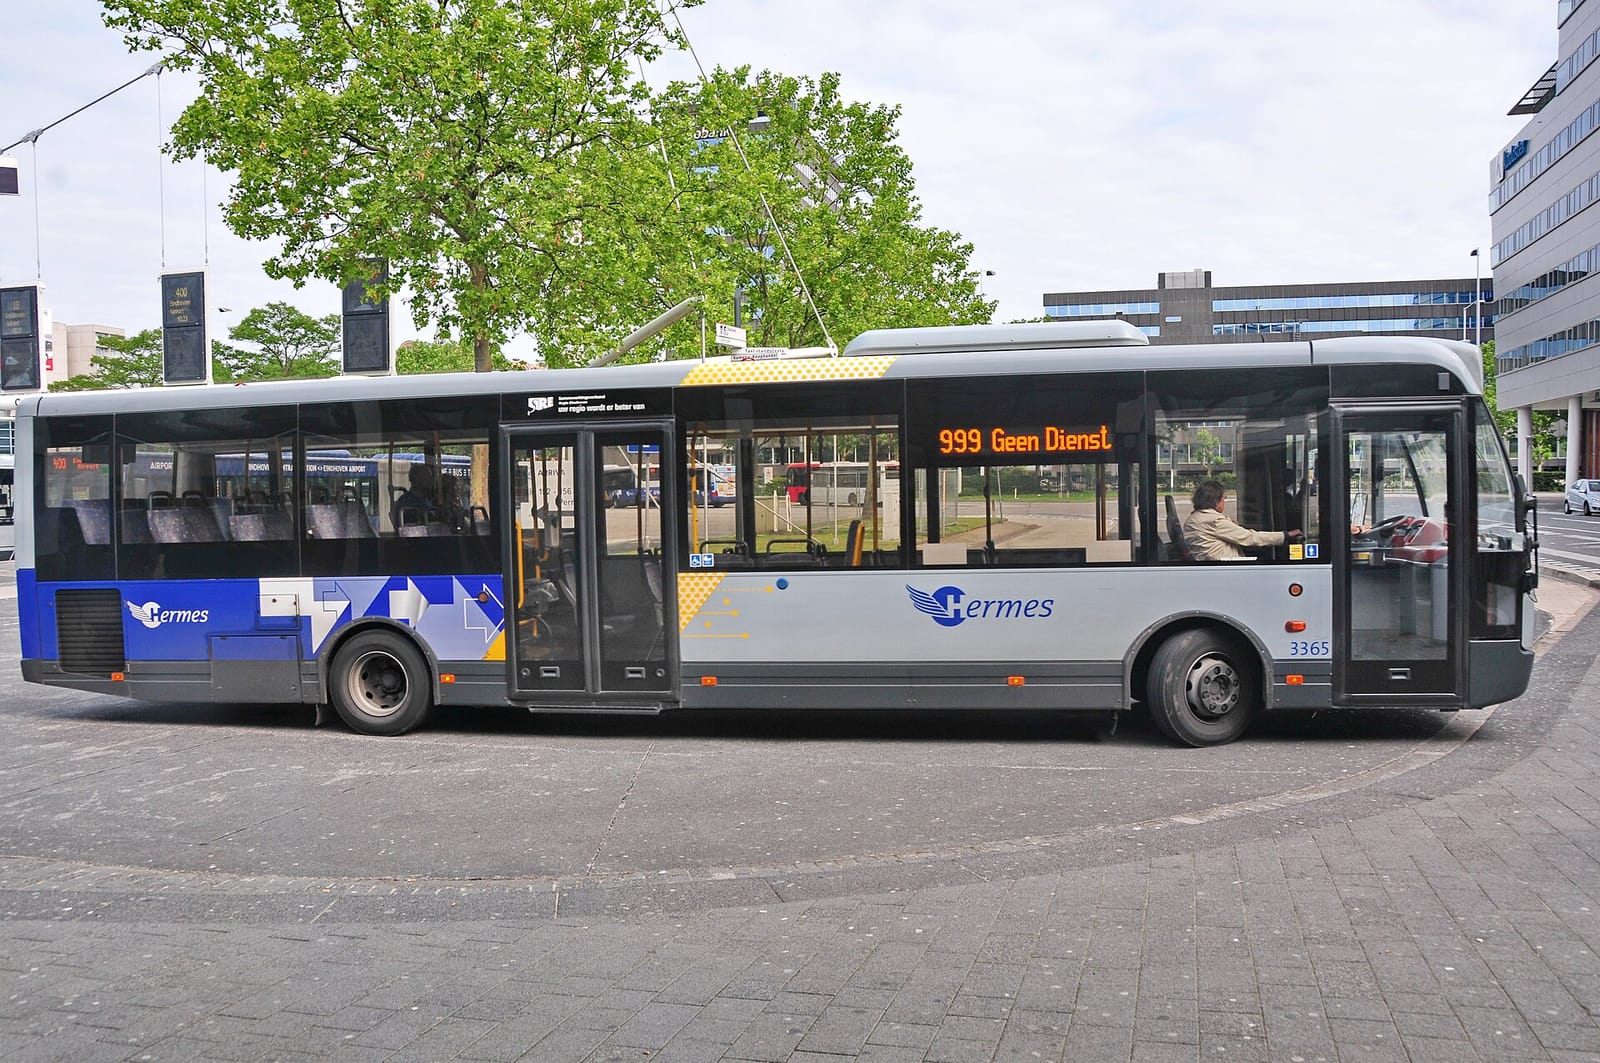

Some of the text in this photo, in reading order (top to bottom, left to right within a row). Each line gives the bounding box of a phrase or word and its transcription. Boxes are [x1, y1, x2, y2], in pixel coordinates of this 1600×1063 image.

[939, 426, 1111, 453] 999 Geen Dienst
[150, 462, 173, 470] AIRPOR
[144, 603, 209, 626] Hermes
[935, 588, 1054, 624] Hermes
[1290, 641, 1329, 656] 3365
